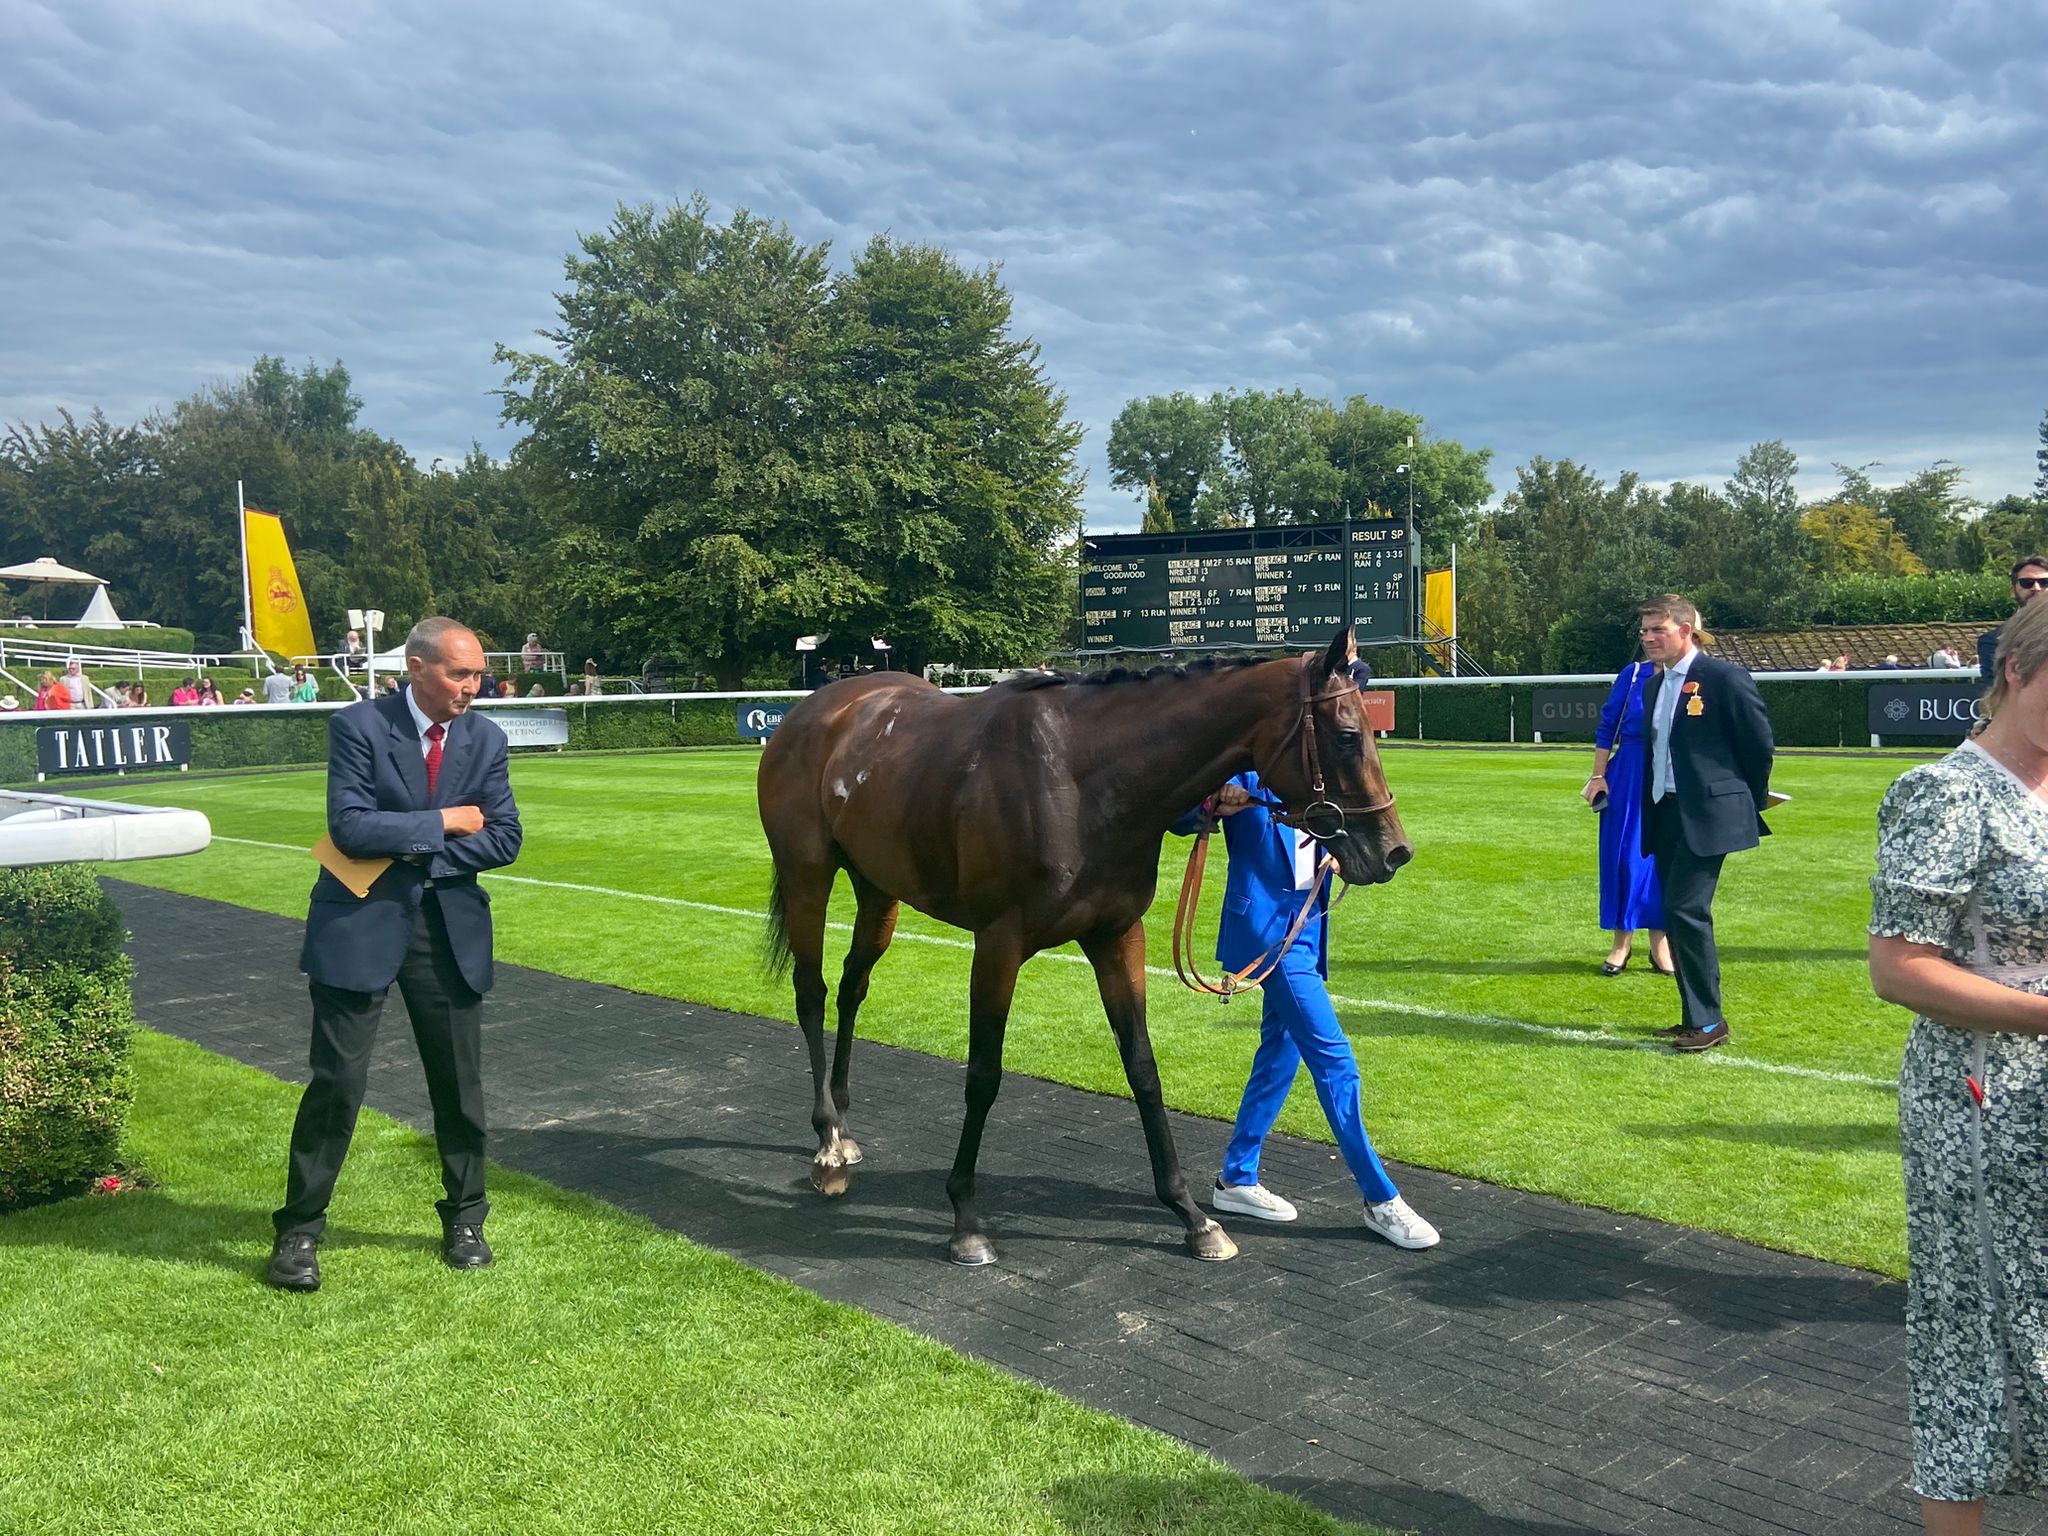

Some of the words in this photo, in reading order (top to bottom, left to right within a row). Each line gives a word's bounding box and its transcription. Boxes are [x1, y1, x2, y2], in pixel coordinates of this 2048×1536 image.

[1352, 531, 1387, 541] RESULT
[1391, 530, 1404, 540] SP
[1317, 554, 1322, 562] 6
[1325, 553, 1341, 561] RAN
[1353, 552, 1372, 560] RACE
[1376, 551, 1382, 559] 4
[1088, 564, 1122, 572] WELCOME
[1128, 563, 1138, 571] TO
[1180, 560, 1197, 568] RACE
[1225, 558, 1234, 566] 15
[1376, 560, 1381, 568] 6
[1103, 571, 1145, 580] GOODWOOD
[1255, 571, 1284, 579] WINNER
[1287, 570, 1292, 578] 2
[1392, 573, 1403, 581] SP
[1169, 576, 1196, 584] WINNER
[1111, 587, 1127, 595] SOFT
[1298, 584, 1307, 592] 7F
[1313, 584, 1322, 592] 13
[1324, 583, 1341, 591] RUN
[1374, 583, 1379, 591] 2
[1386, 582, 1399, 590] 9/1
[1208, 589, 1218, 598] 6F
[1229, 589, 1234, 597] 7
[1386, 591, 1399, 599] 7/1
[1170, 607, 1197, 616] WINNER
[1256, 604, 1285, 613] WINNER
[1099, 610, 1115, 618] RACE
[1122, 610, 1131, 618] 7F
[1150, 609, 1166, 617] RUN
[1229, 620, 1234, 628] 6
[1236, 619, 1252, 627] RAN
[1268, 618, 1286, 626] RACE
[1324, 616, 1341, 624] RUN
[1087, 635, 1114, 643] WINNER
[1170, 635, 1197, 644] WINNER
[1256, 634, 1285, 642] WINNER
[1542, 703, 1597, 719] GUSB
[1920, 699, 1981, 720] BUCC
[767, 715, 782, 723] EBF
[504, 728, 542, 736] RKETING
[55, 726, 173, 769] TATLER
